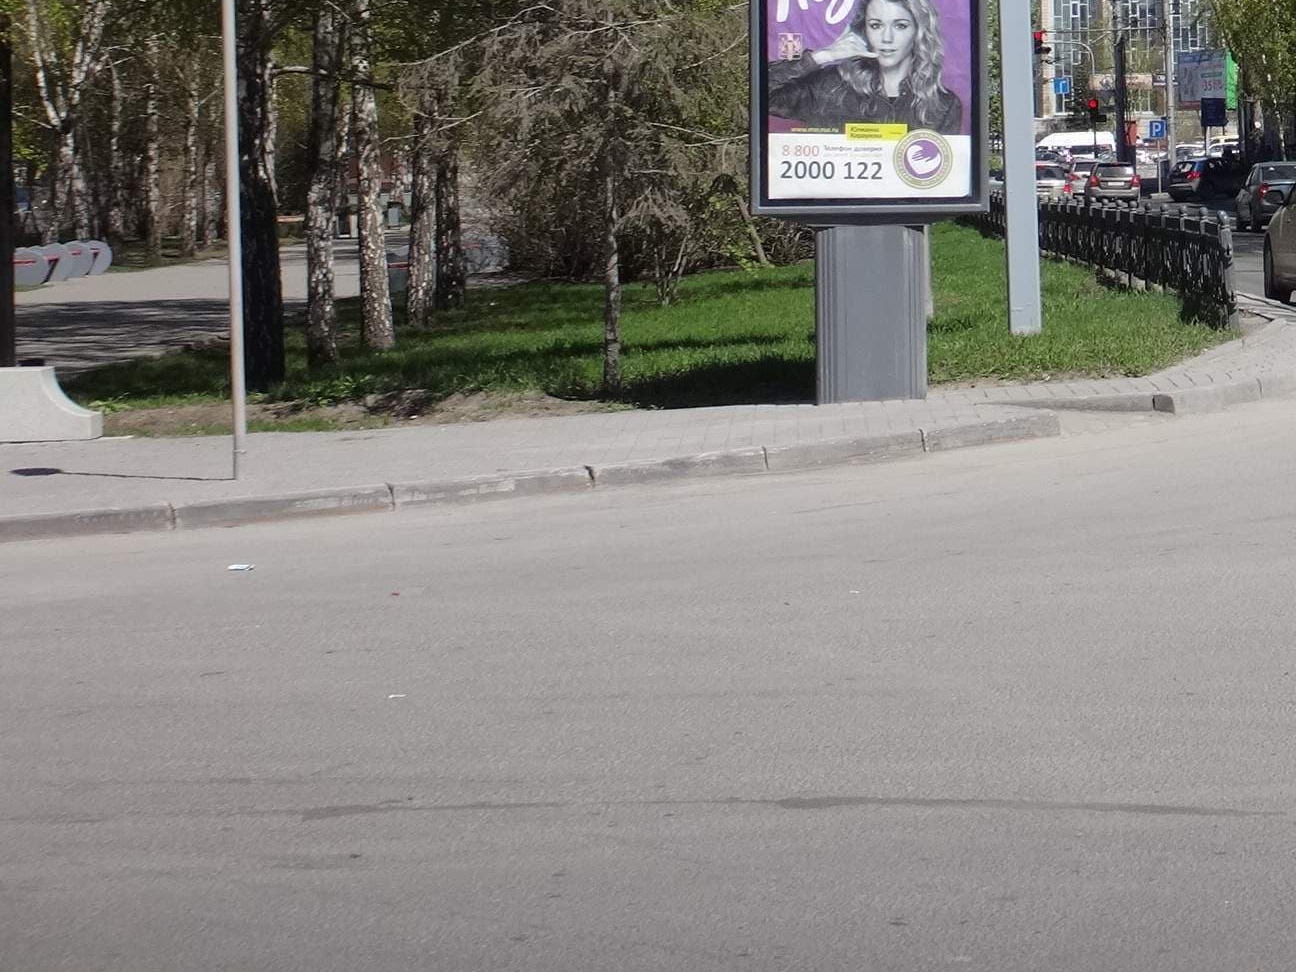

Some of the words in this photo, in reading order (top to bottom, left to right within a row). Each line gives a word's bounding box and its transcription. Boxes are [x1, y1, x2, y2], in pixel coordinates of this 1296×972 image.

[782, 144, 790, 157] 8
[794, 145, 820, 157] 800
[780, 160, 835, 179] 2000
[843, 161, 883, 180] 122
